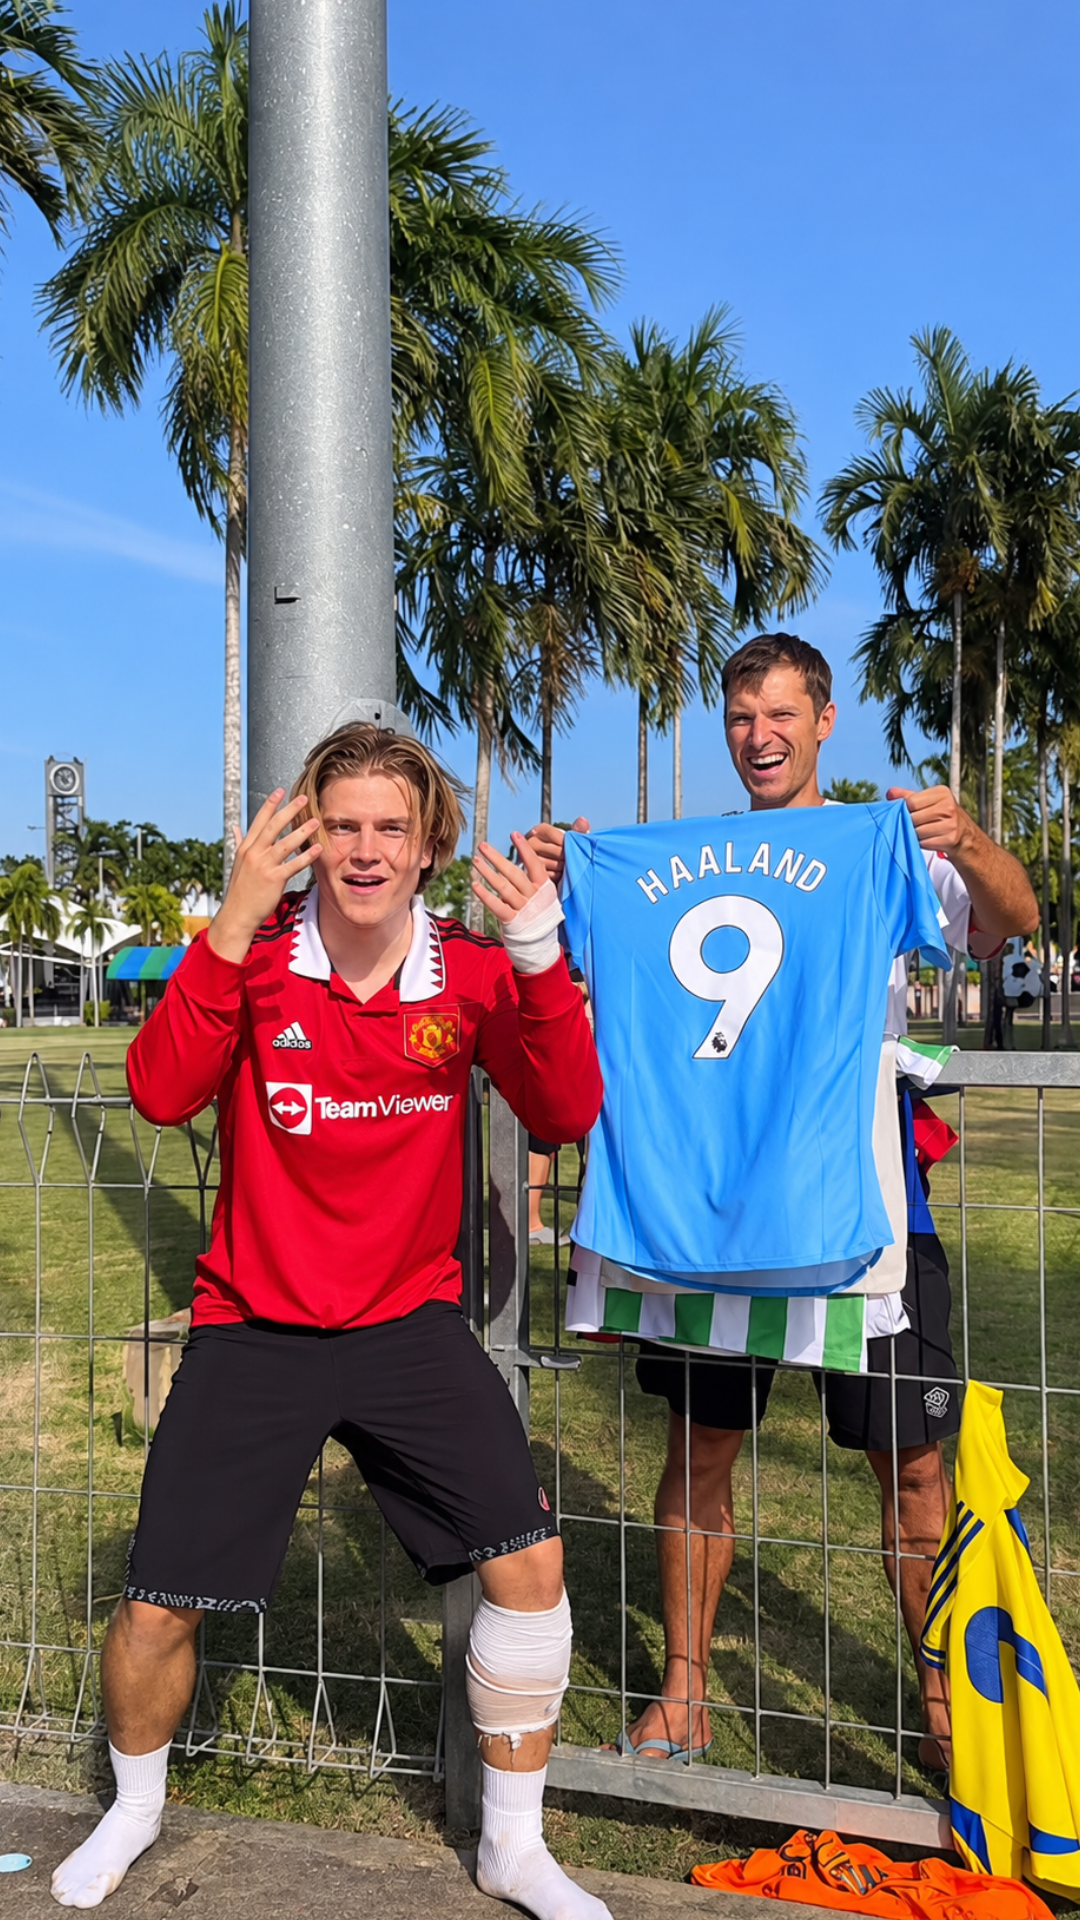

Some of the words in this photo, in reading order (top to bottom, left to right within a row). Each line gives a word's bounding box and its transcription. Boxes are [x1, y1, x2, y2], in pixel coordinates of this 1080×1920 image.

[636, 841, 827, 904] HAALAND
[668, 894, 785, 1059] 9
[314, 1094, 453, 1119] TeamViewer
